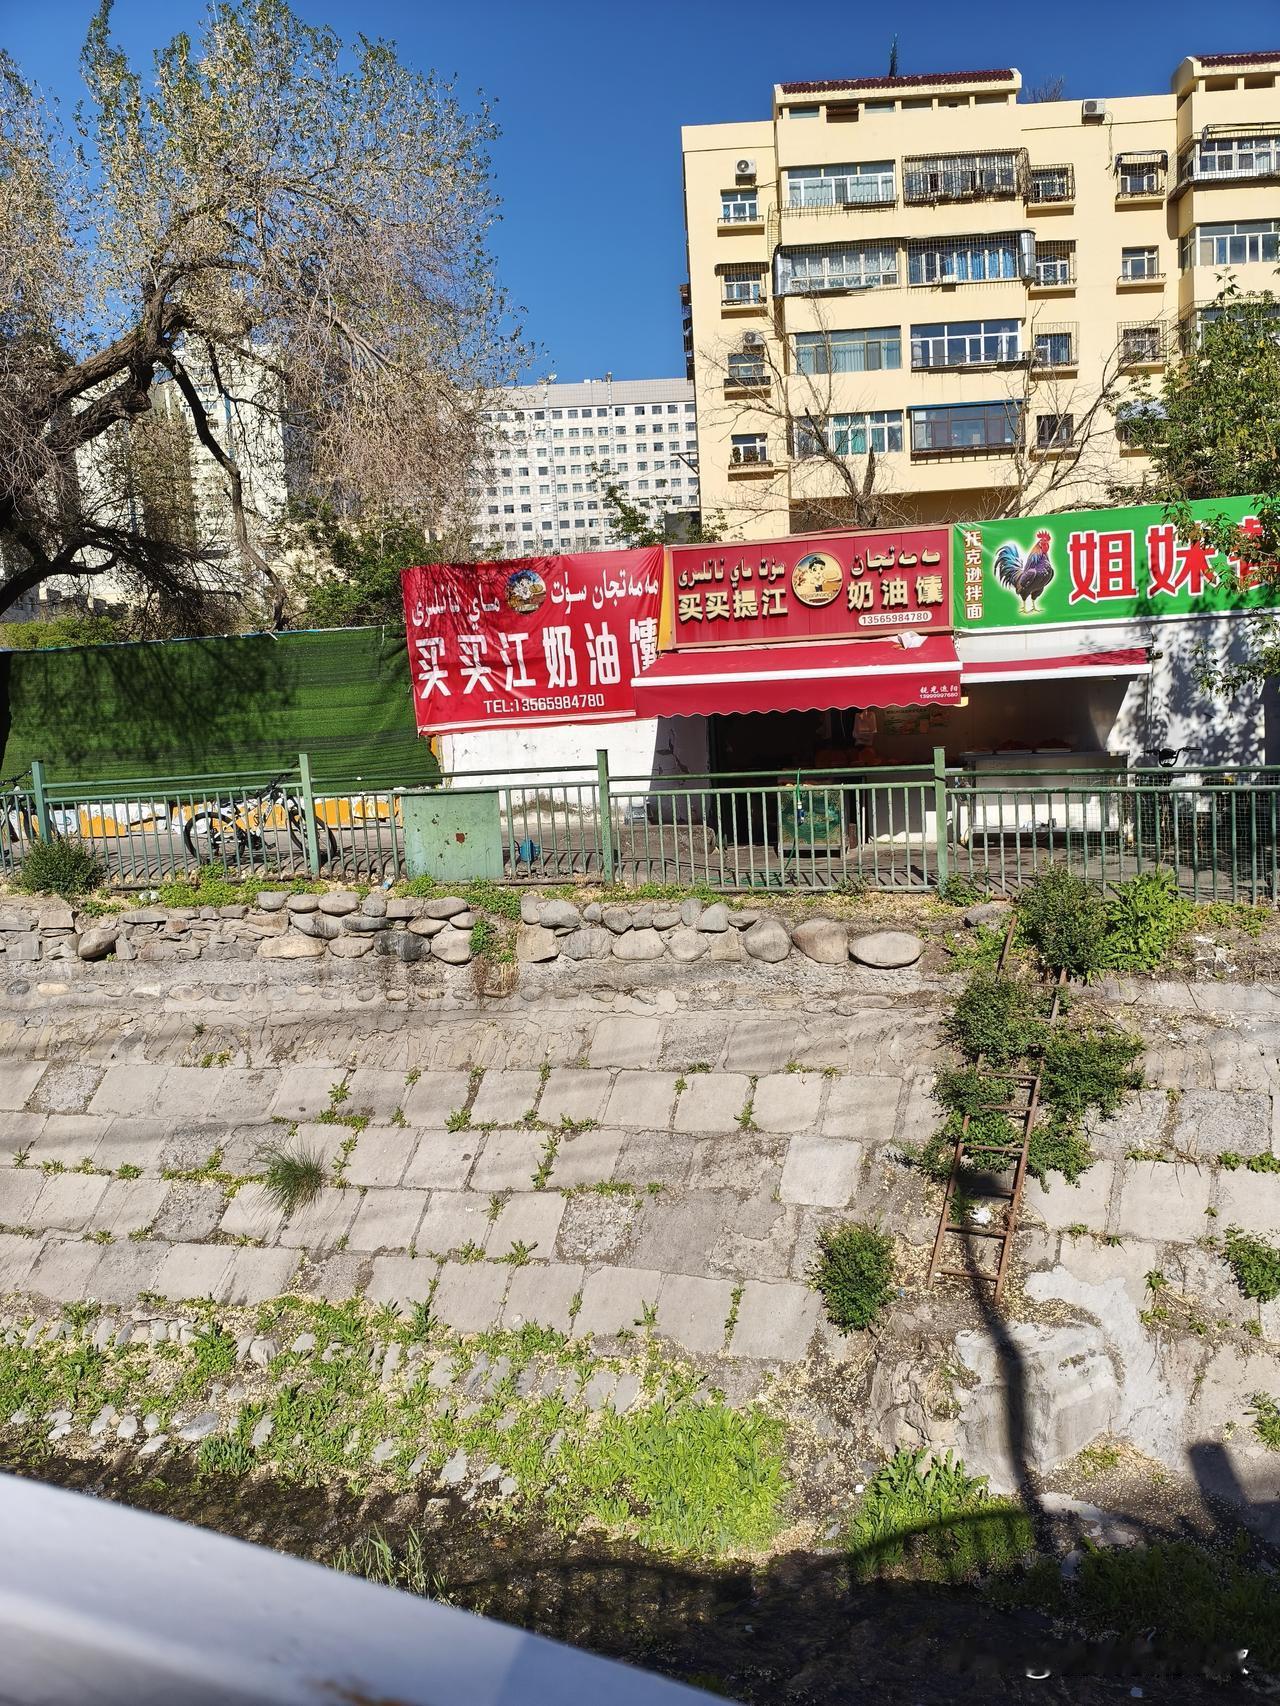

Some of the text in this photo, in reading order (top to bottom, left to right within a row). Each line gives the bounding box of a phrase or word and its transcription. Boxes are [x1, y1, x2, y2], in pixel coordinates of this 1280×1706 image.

[965, 530, 982, 619] 托克逊拌面
[678, 575, 944, 622] 买买提江 奶油馕
[862, 612, 929, 624] 13565984780
[483, 693, 605, 713] TEL:13565984780
